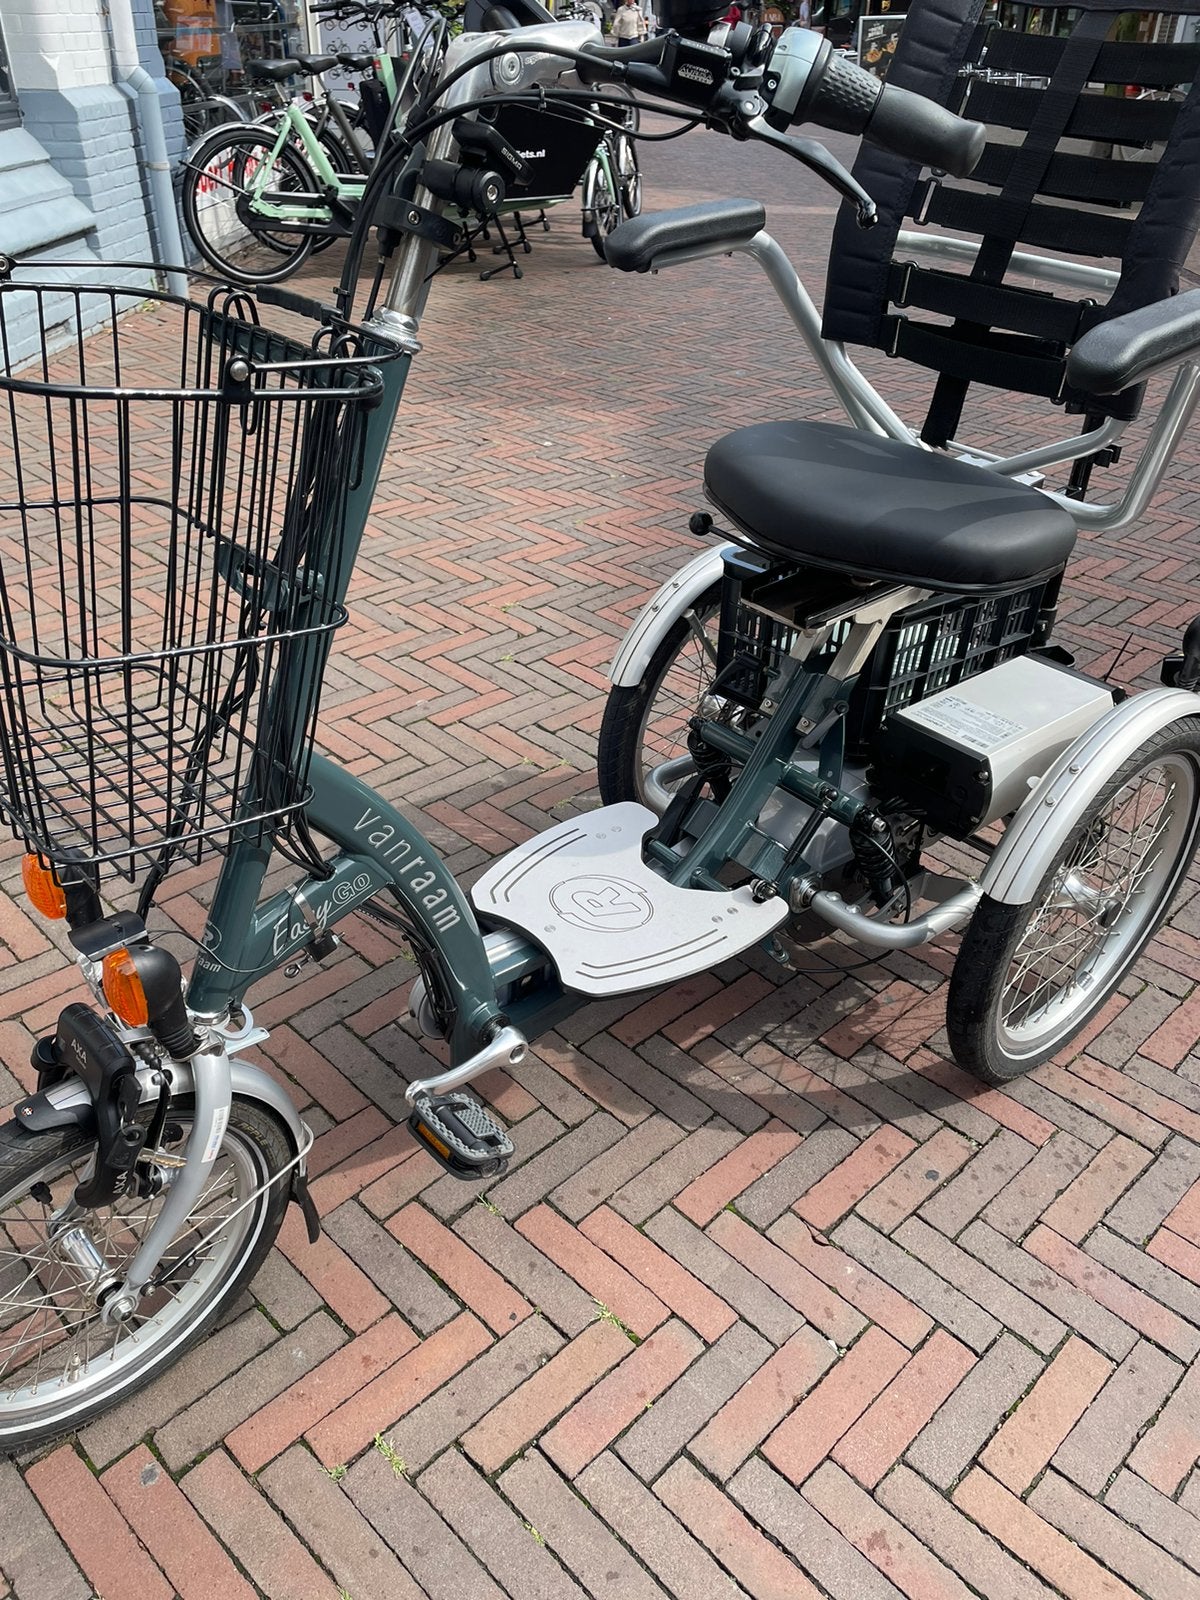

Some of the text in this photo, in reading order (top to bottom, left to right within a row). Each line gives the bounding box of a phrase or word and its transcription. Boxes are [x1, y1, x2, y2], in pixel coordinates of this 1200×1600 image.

[501, 147, 523, 171] SIGMA
[353, 807, 461, 933] vanraam
[70, 1038, 88, 1064] AXA
[236, 1121, 269, 1147] APPLE
[112, 1170, 129, 1194] AXA
